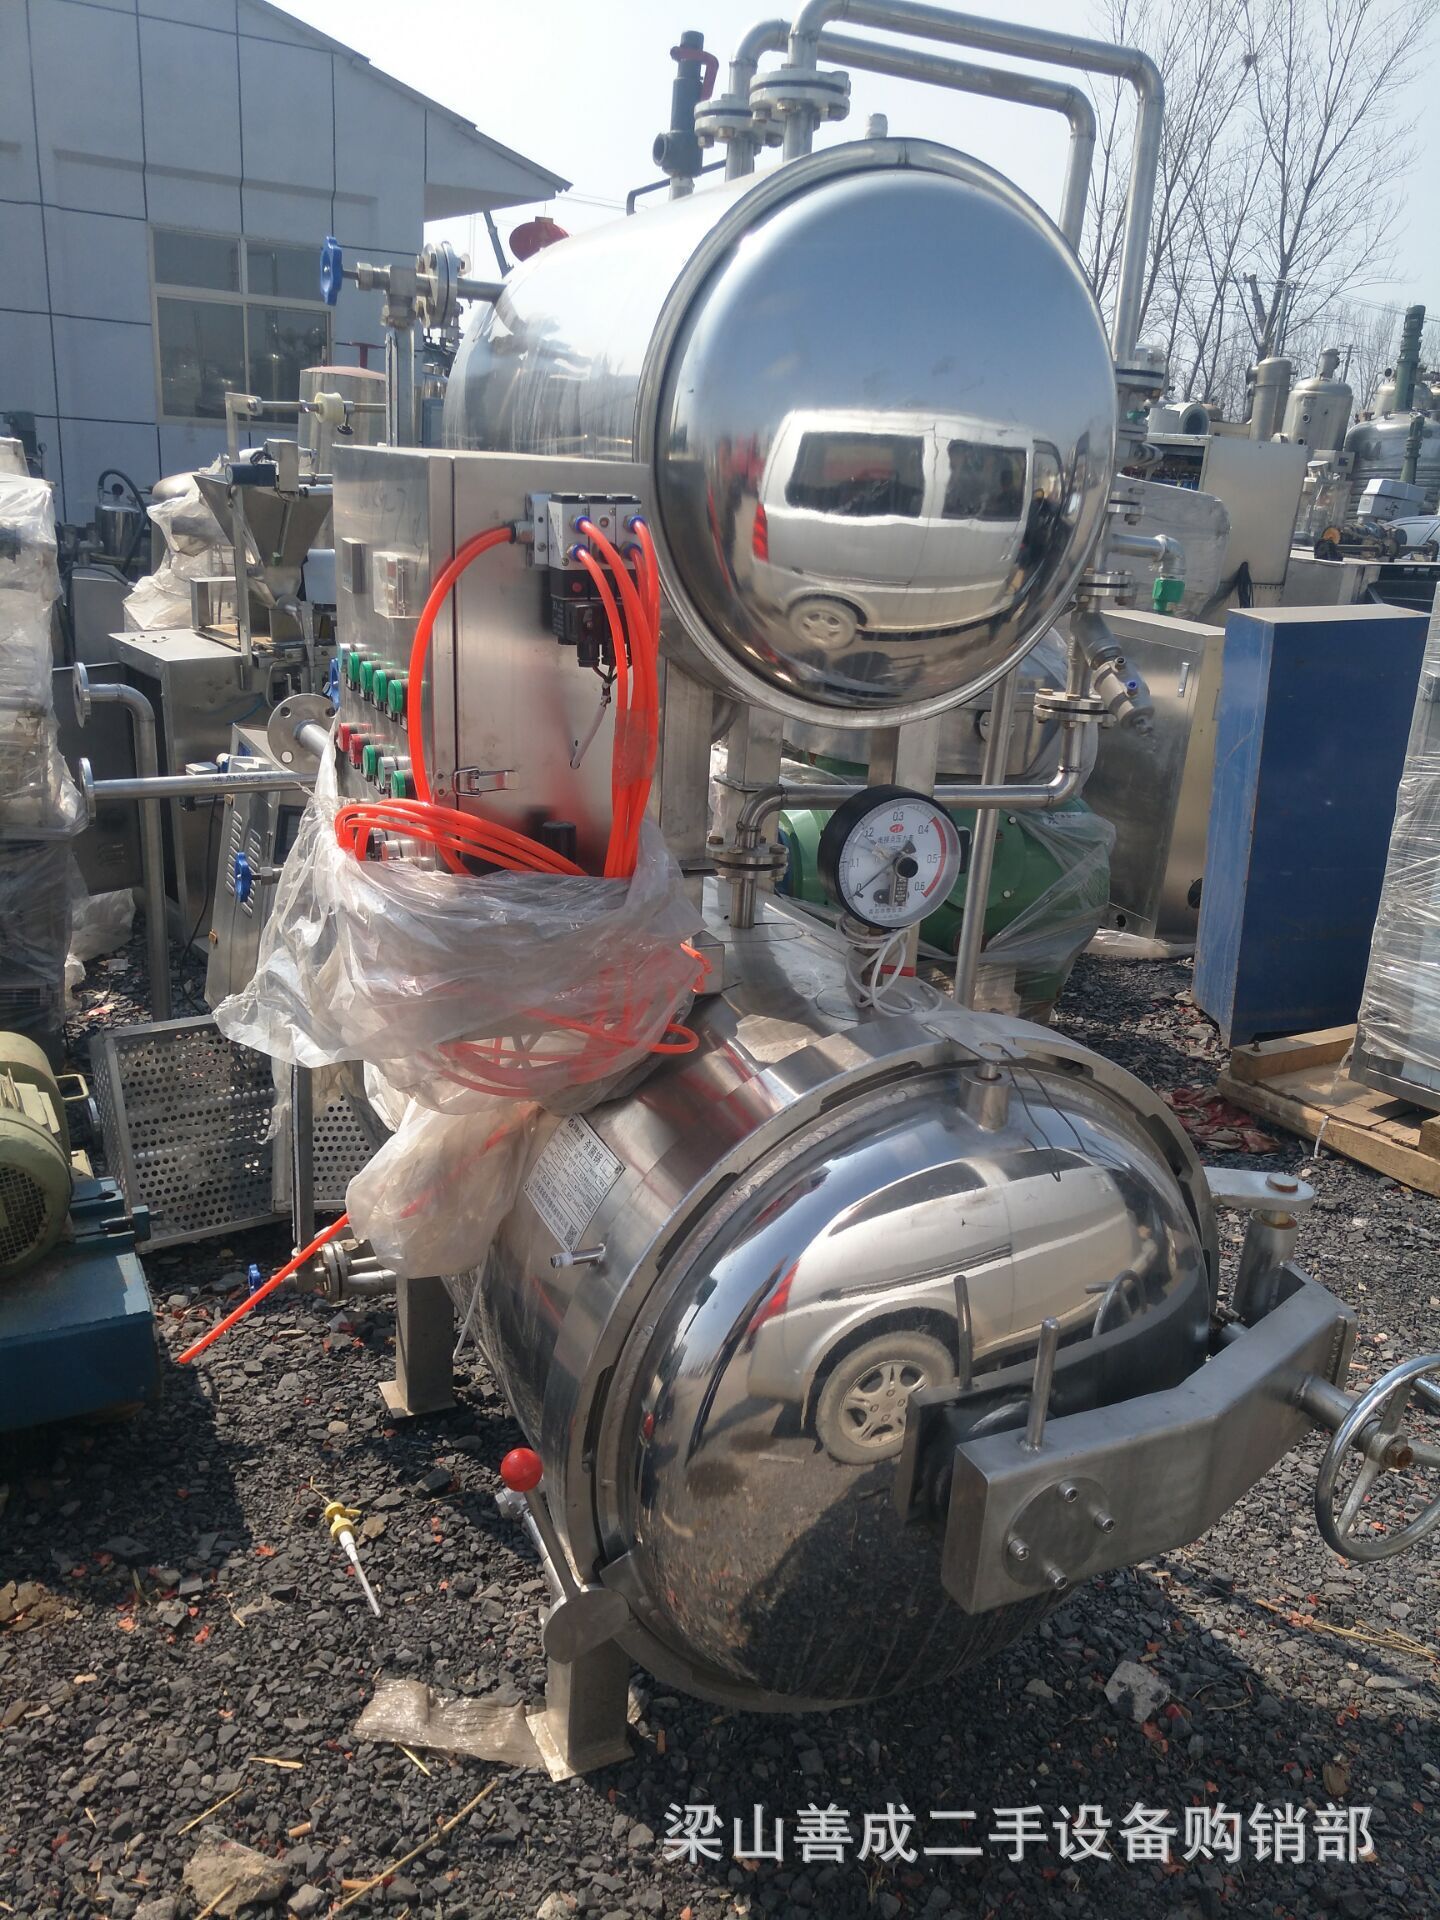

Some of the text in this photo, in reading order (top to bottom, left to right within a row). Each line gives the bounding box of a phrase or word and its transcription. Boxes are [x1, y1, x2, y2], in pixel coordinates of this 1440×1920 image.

[893, 811, 904, 821] 0.3
[918, 825, 929, 834] 0.4
[927, 855, 938, 863] 0.5
[915, 882, 925, 891] 0.6
